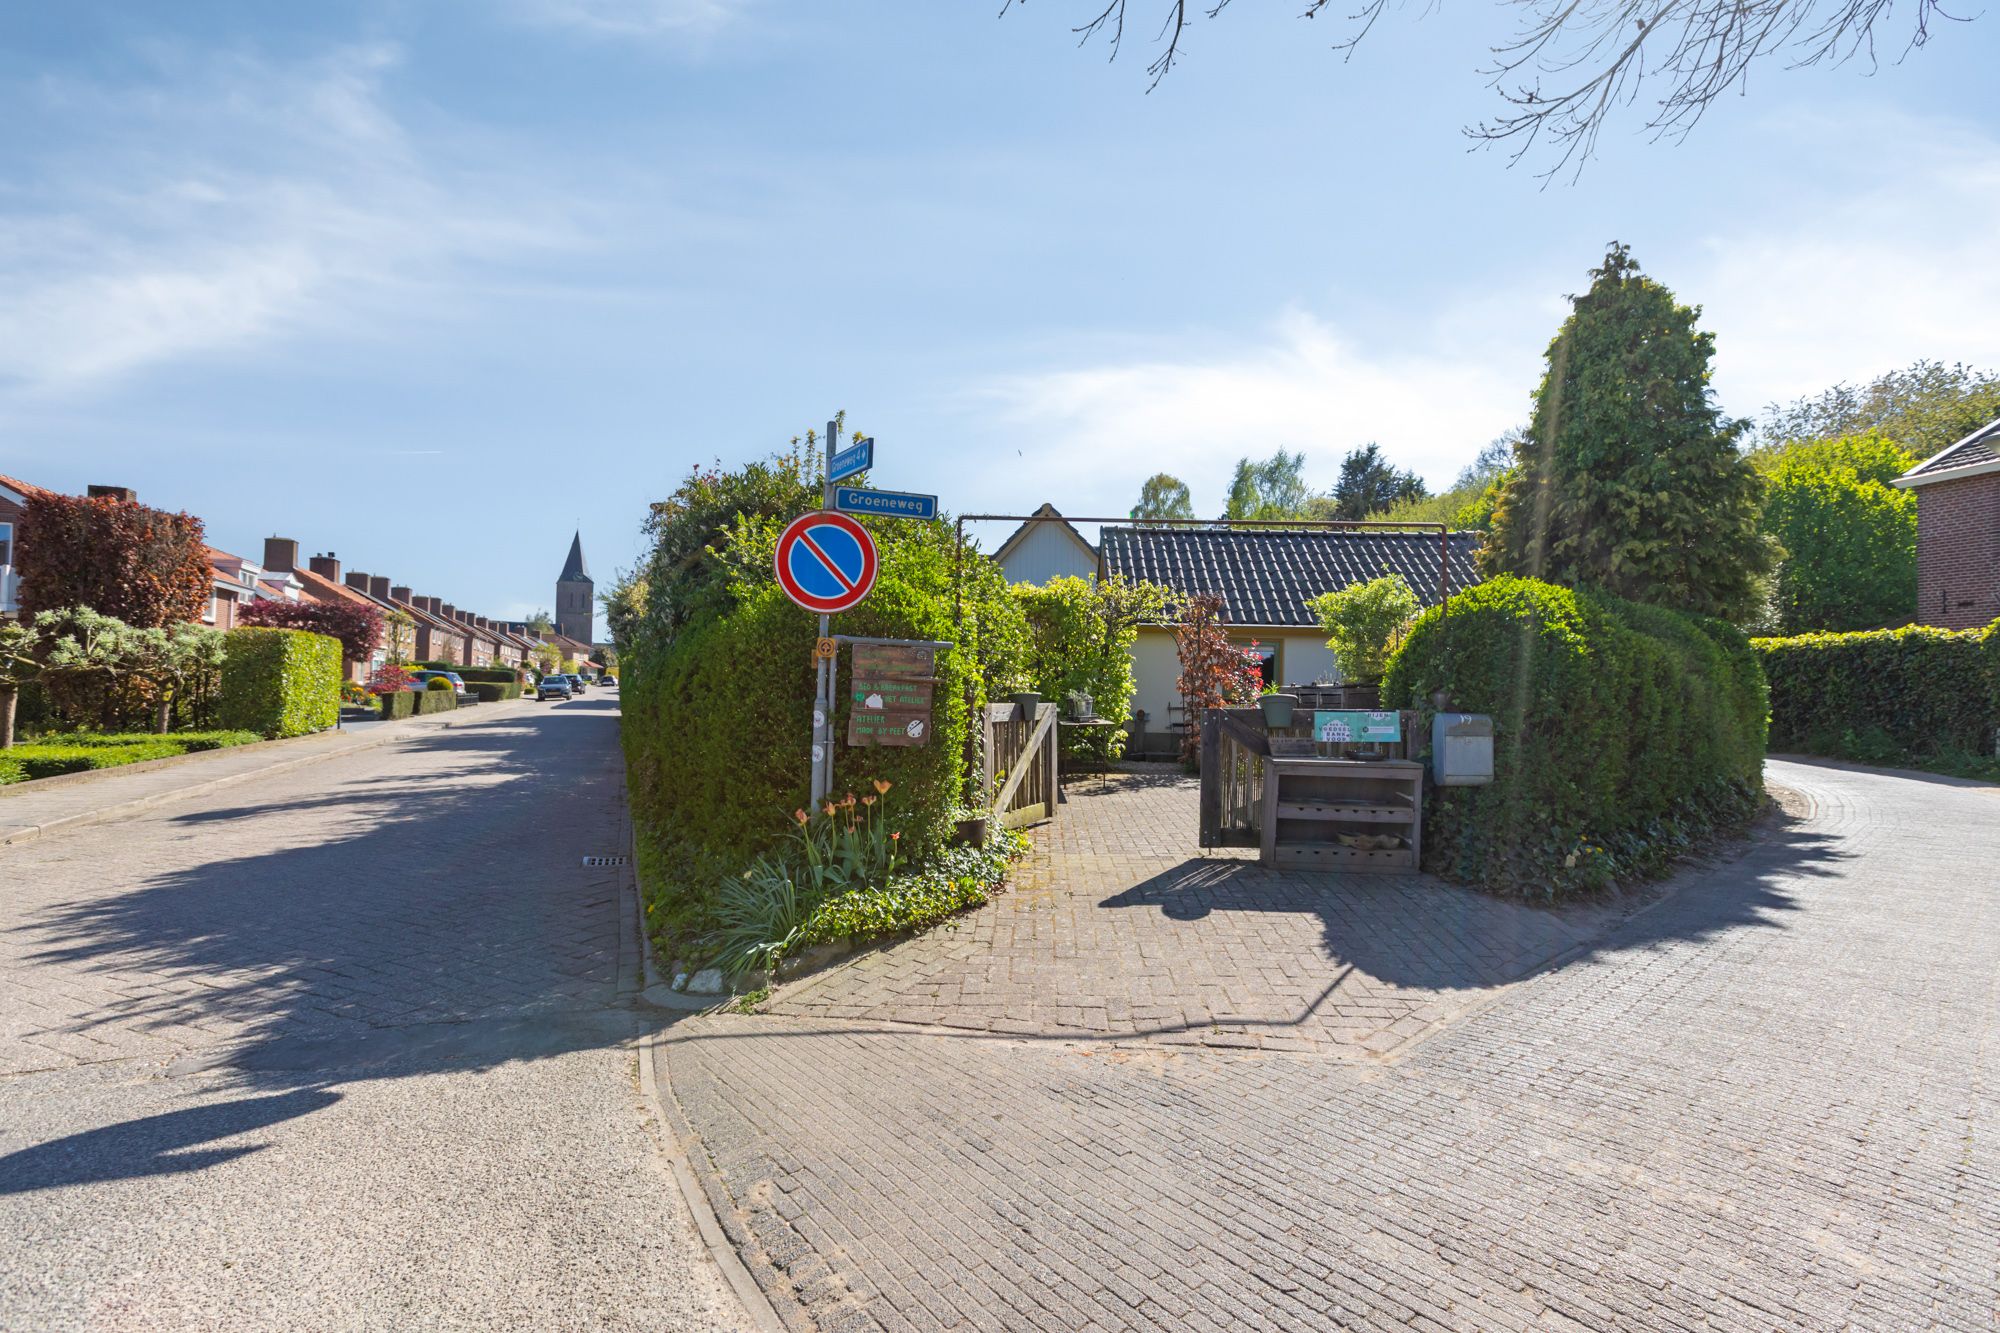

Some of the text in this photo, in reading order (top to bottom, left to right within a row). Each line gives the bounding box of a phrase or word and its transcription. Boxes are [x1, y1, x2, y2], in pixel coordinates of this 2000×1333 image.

[832, 454, 856, 473] Groeneweg
[849, 493, 923, 513] Groeneweg
[1460, 714, 1472, 725] 19
